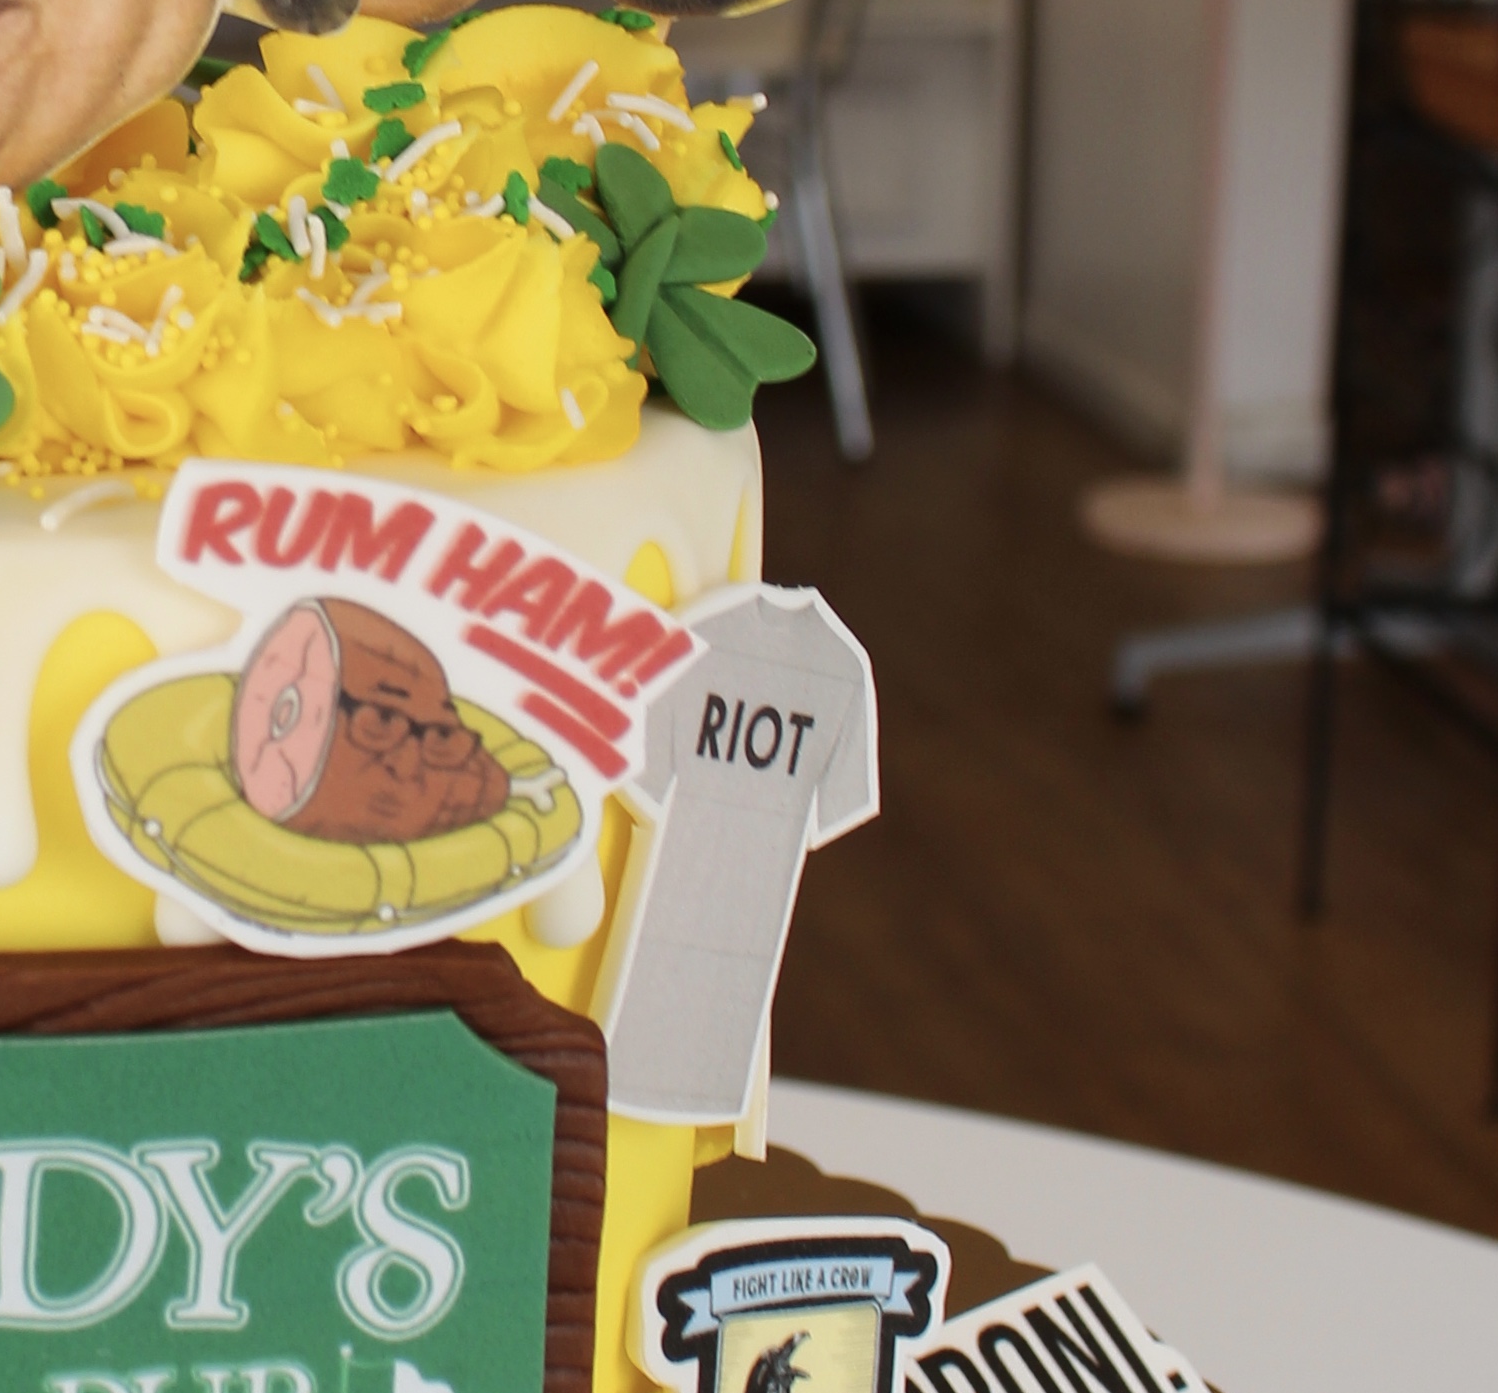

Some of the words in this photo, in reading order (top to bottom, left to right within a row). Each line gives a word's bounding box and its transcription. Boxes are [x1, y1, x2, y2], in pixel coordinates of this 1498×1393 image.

[182, 480, 435, 583] RUM
[432, 522, 696, 699] HAM!
[697, 694, 814, 777] RIOT
[733, 1273, 776, 1301] FIGHT
[782, 1268, 812, 1293] LIKE
[817, 1266, 827, 1289] A
[830, 1265, 873, 1289] CROW
